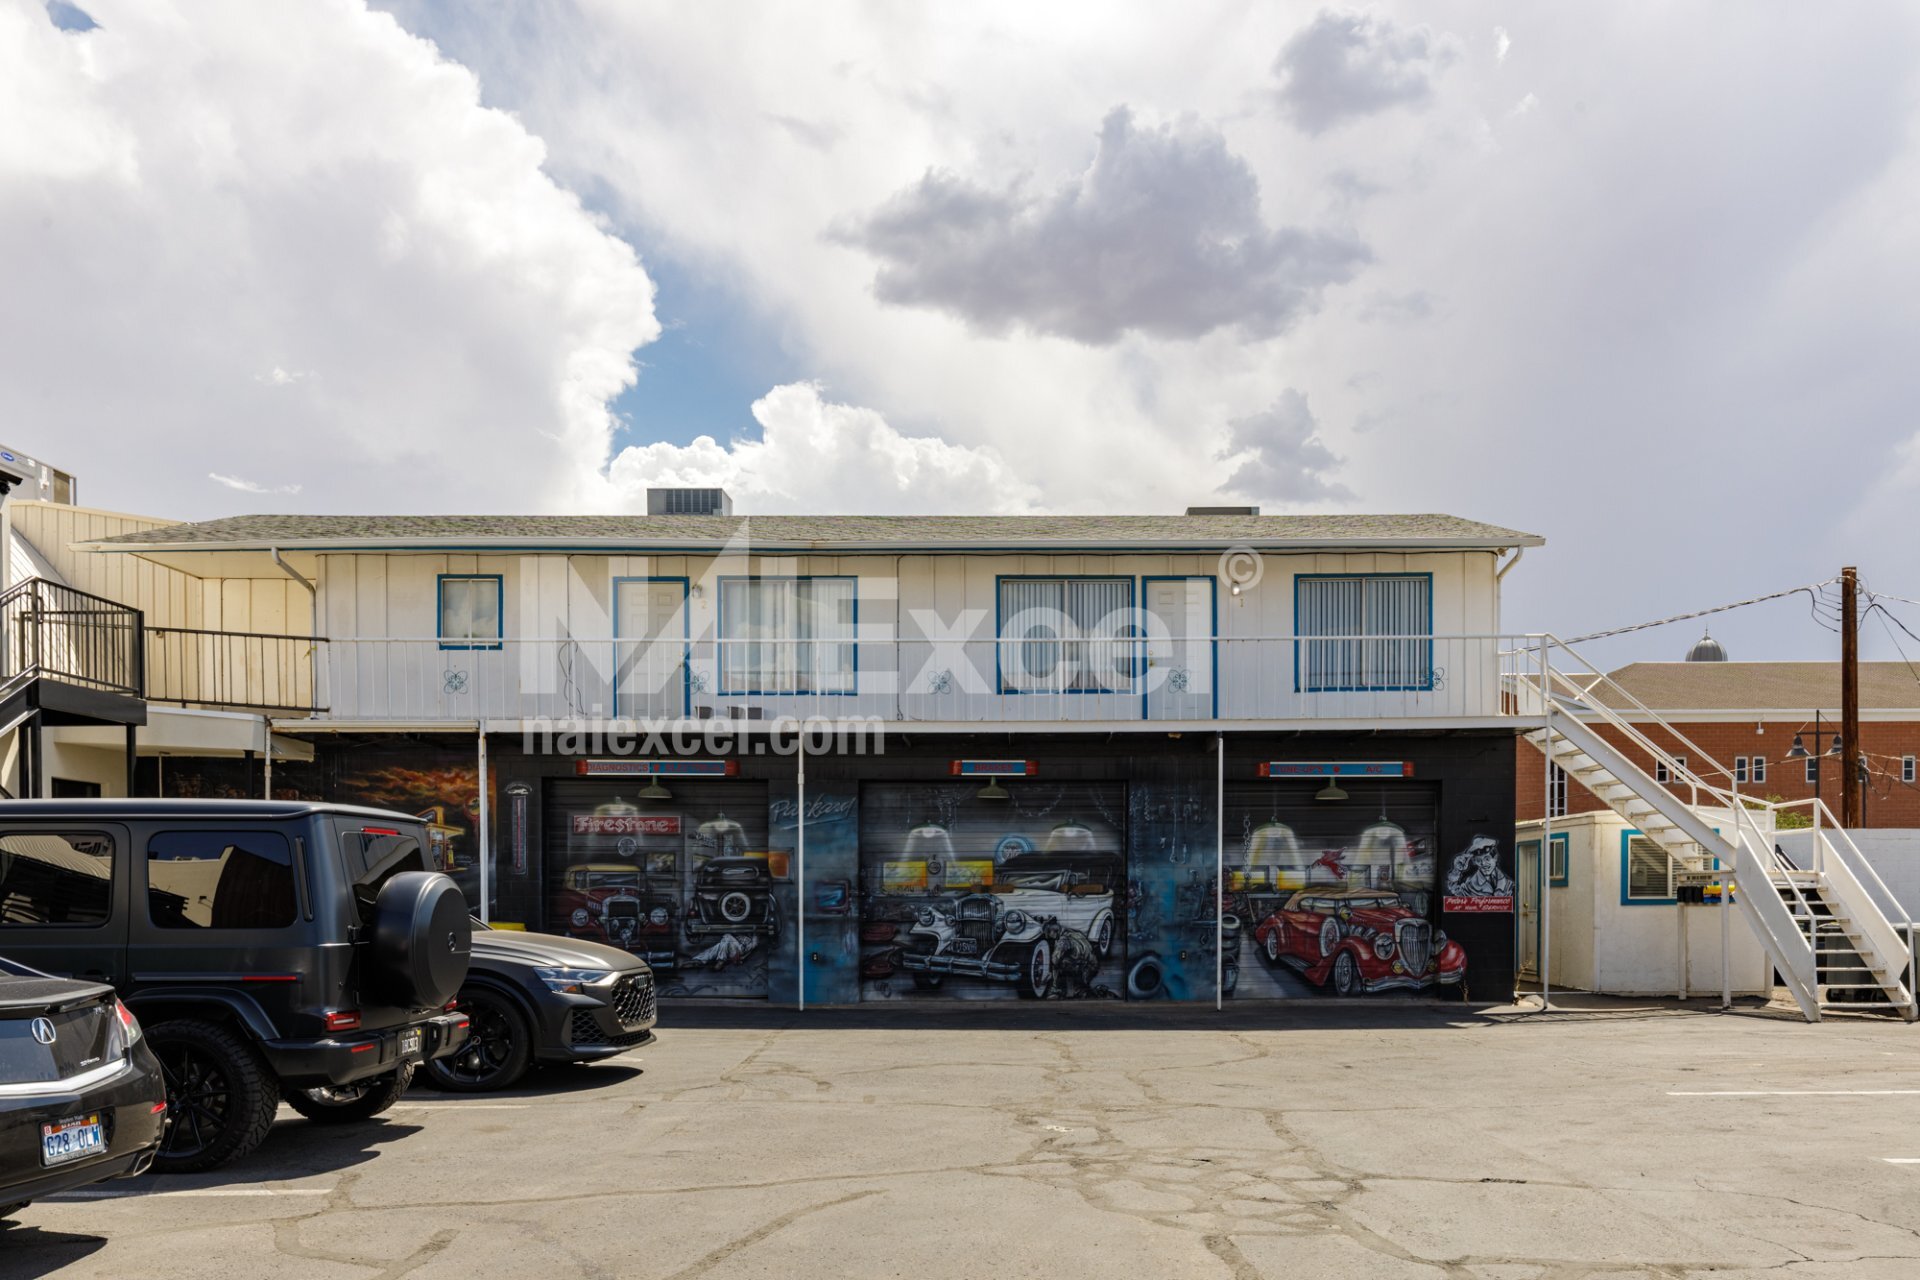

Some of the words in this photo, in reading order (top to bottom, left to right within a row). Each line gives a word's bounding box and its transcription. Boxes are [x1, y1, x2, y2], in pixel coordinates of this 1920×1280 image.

[587, 763, 648, 772] DIAGNOSTICS
[575, 816, 669, 832] Firestone
[46, 1132, 71, 1156] G28
